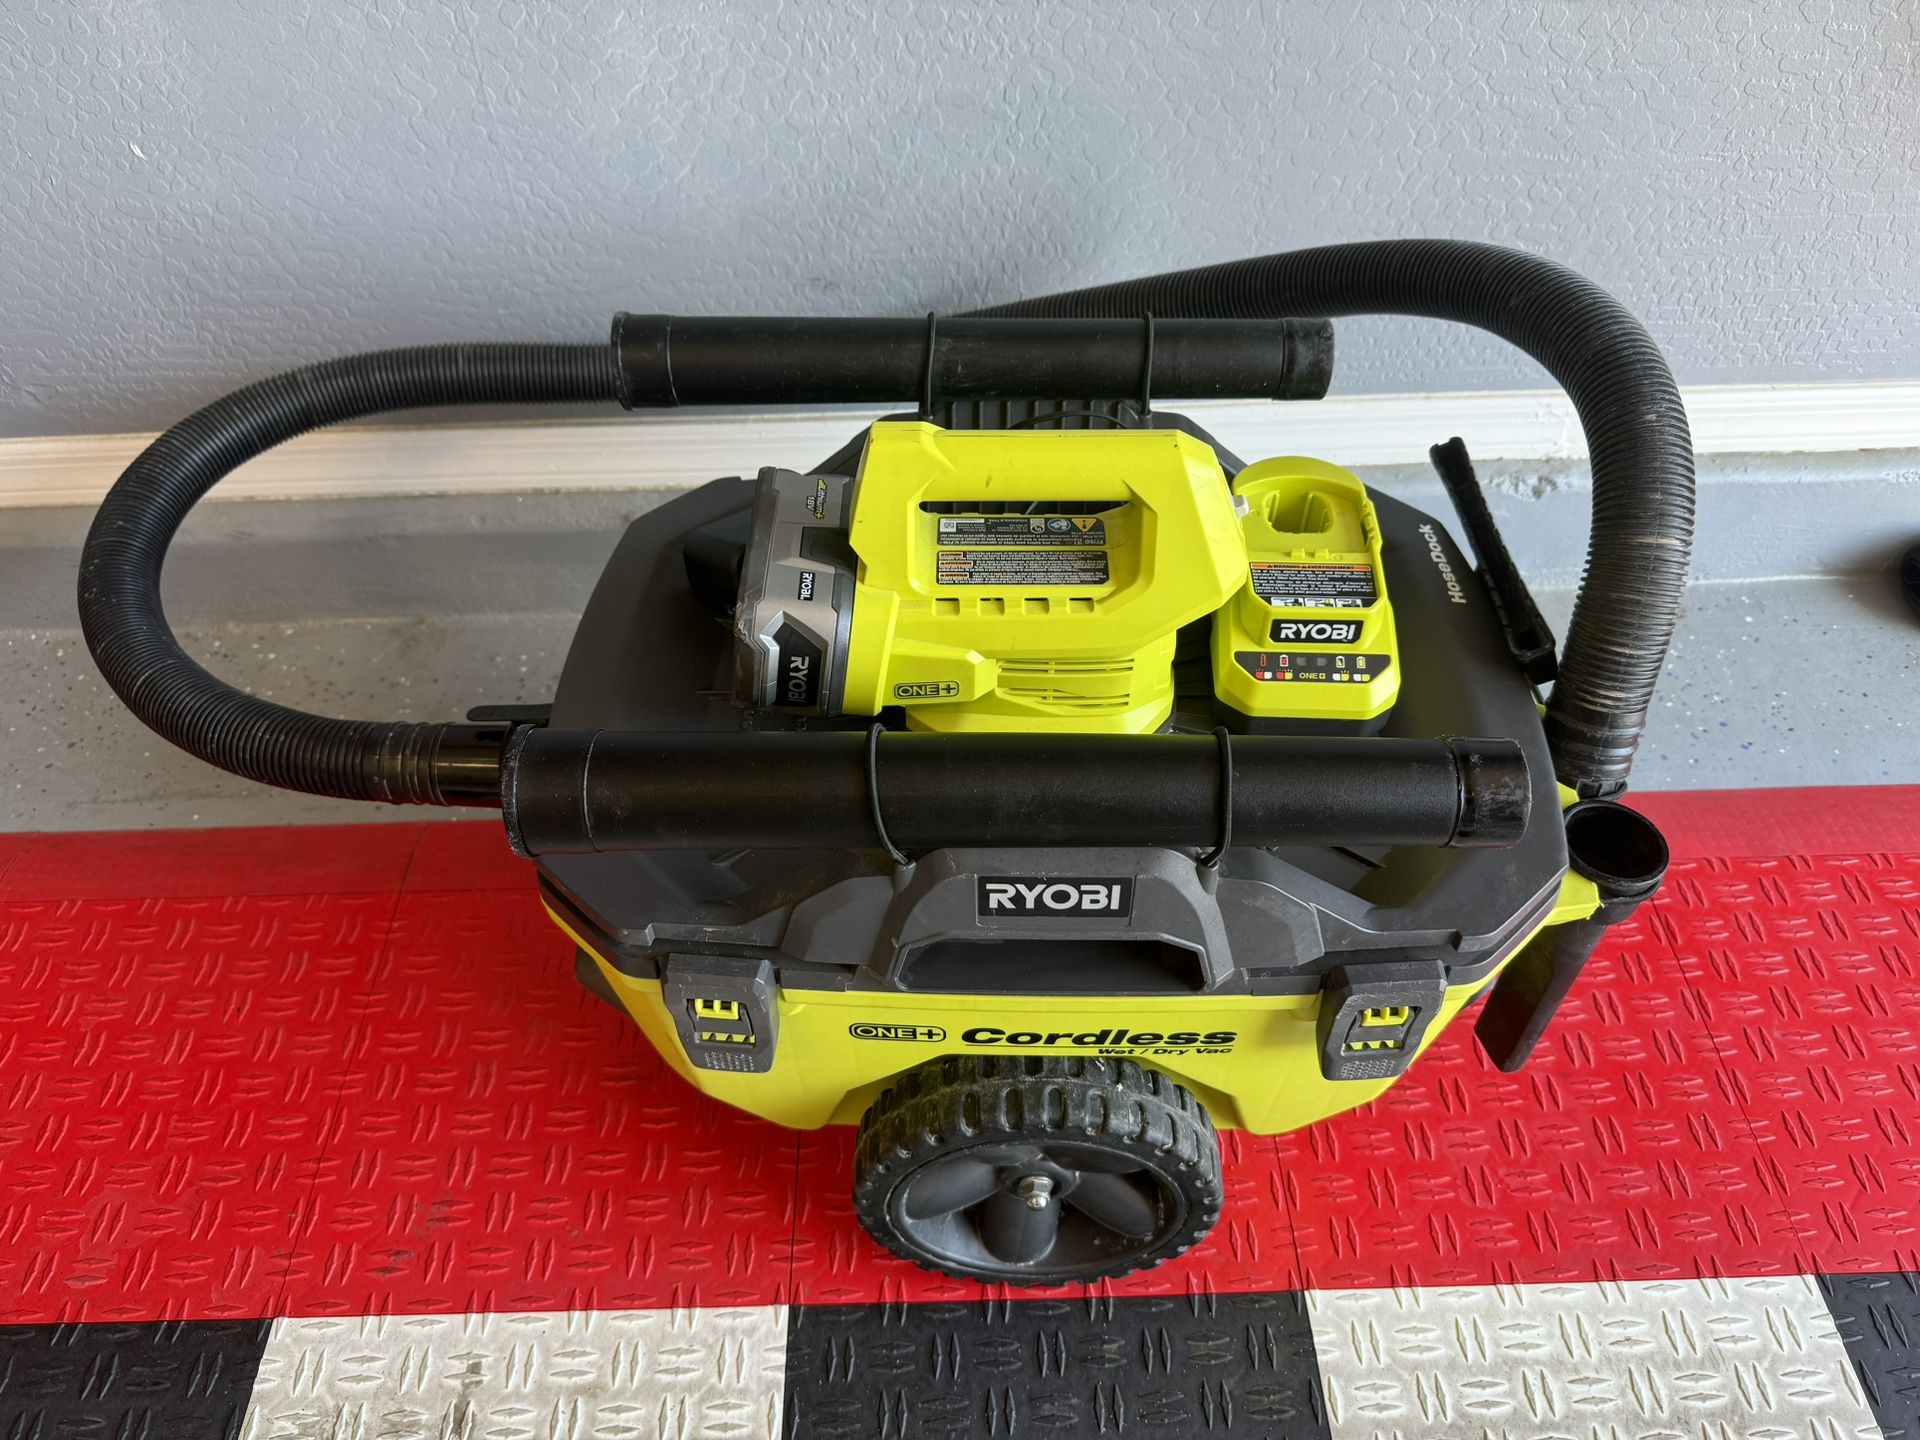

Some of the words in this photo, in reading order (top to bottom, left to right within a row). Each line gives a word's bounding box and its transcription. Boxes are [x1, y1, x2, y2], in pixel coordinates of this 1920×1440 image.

[807, 496, 815, 511] 18V
[1418, 524, 1467, 604] HoseDock
[800, 572, 813, 600] RYOBI
[1280, 623, 1356, 640] RYOBI
[986, 883, 1121, 910] RYOBI
[961, 1027, 1238, 1046] Cordless
[1153, 1048, 1190, 1056] Dry
